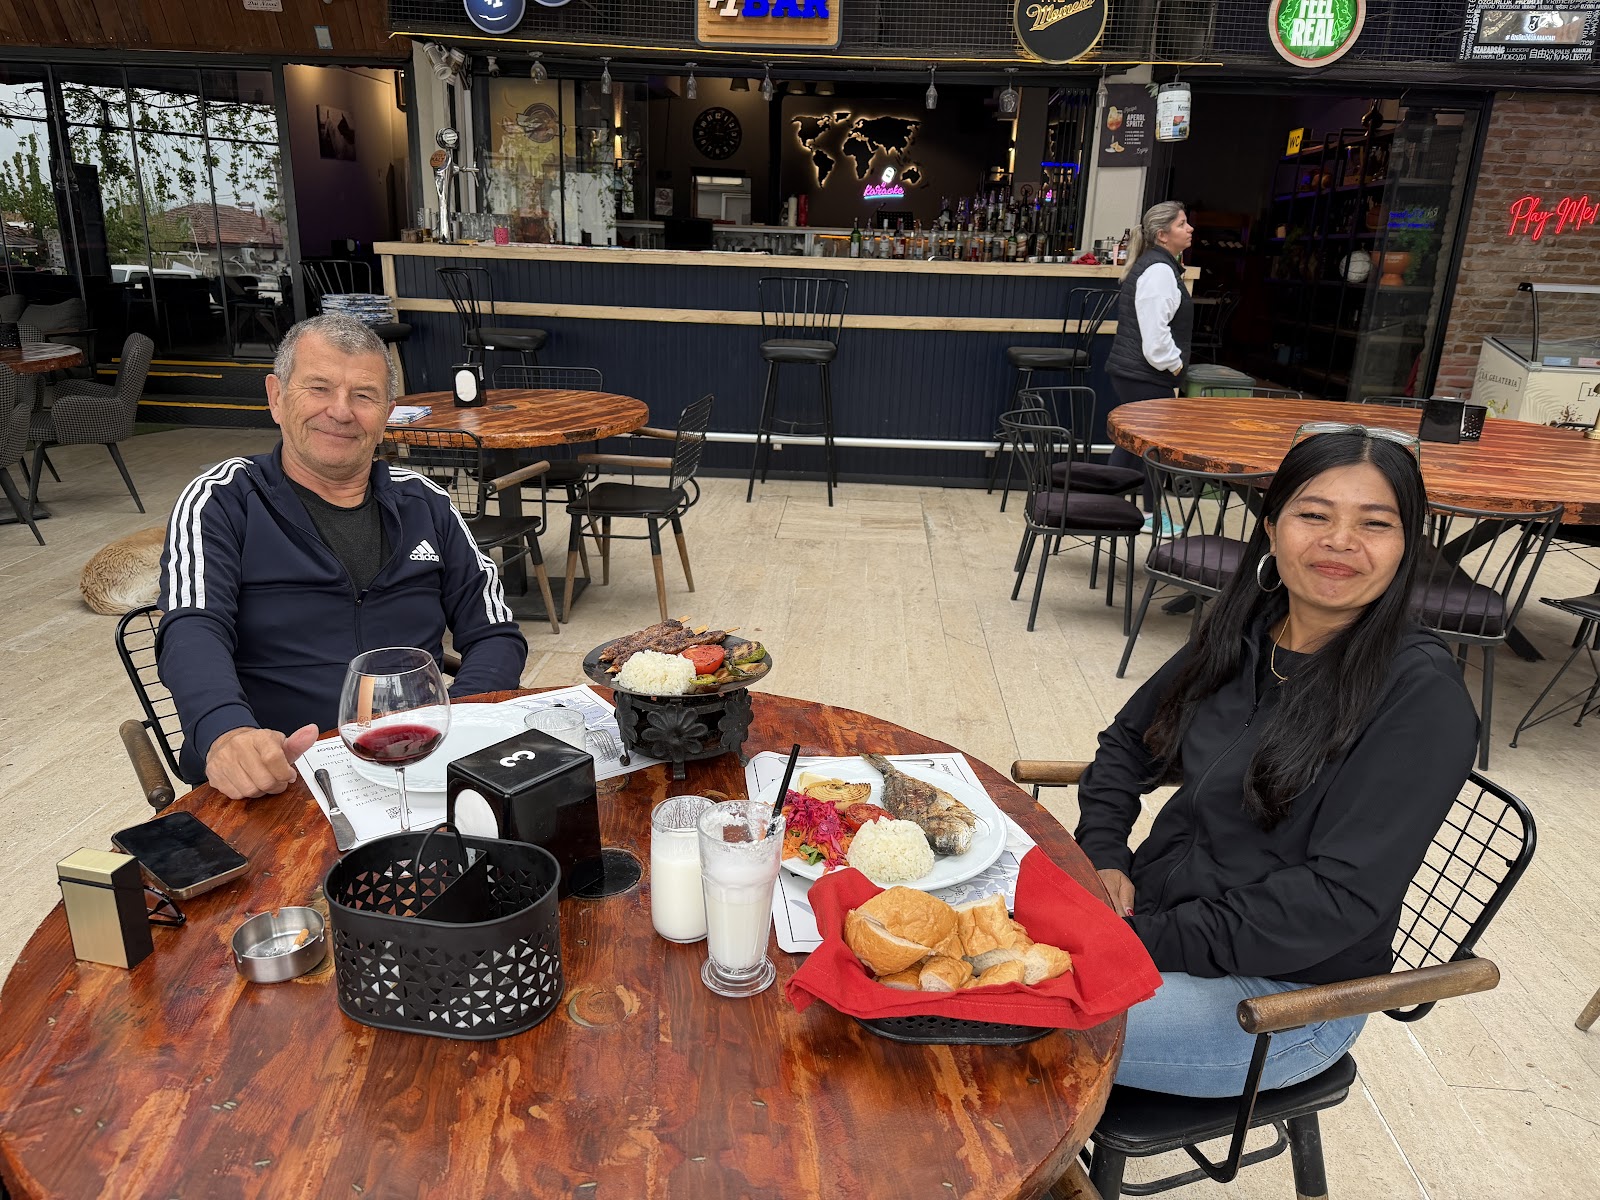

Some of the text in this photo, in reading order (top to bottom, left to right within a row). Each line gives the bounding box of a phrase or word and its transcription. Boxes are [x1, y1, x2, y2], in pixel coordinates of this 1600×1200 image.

[1298, 0, 1334, 18] FEEL
[1290, 19, 1334, 46] REAL
[1529, 48, 1546, 59] 自由
[1290, 135, 1300, 148] WC
[1508, 196, 1554, 241] Play
[1489, 374, 1518, 388] GELATERIA
[409, 553, 440, 562] adidas
[499, 750, 536, 767] 3
